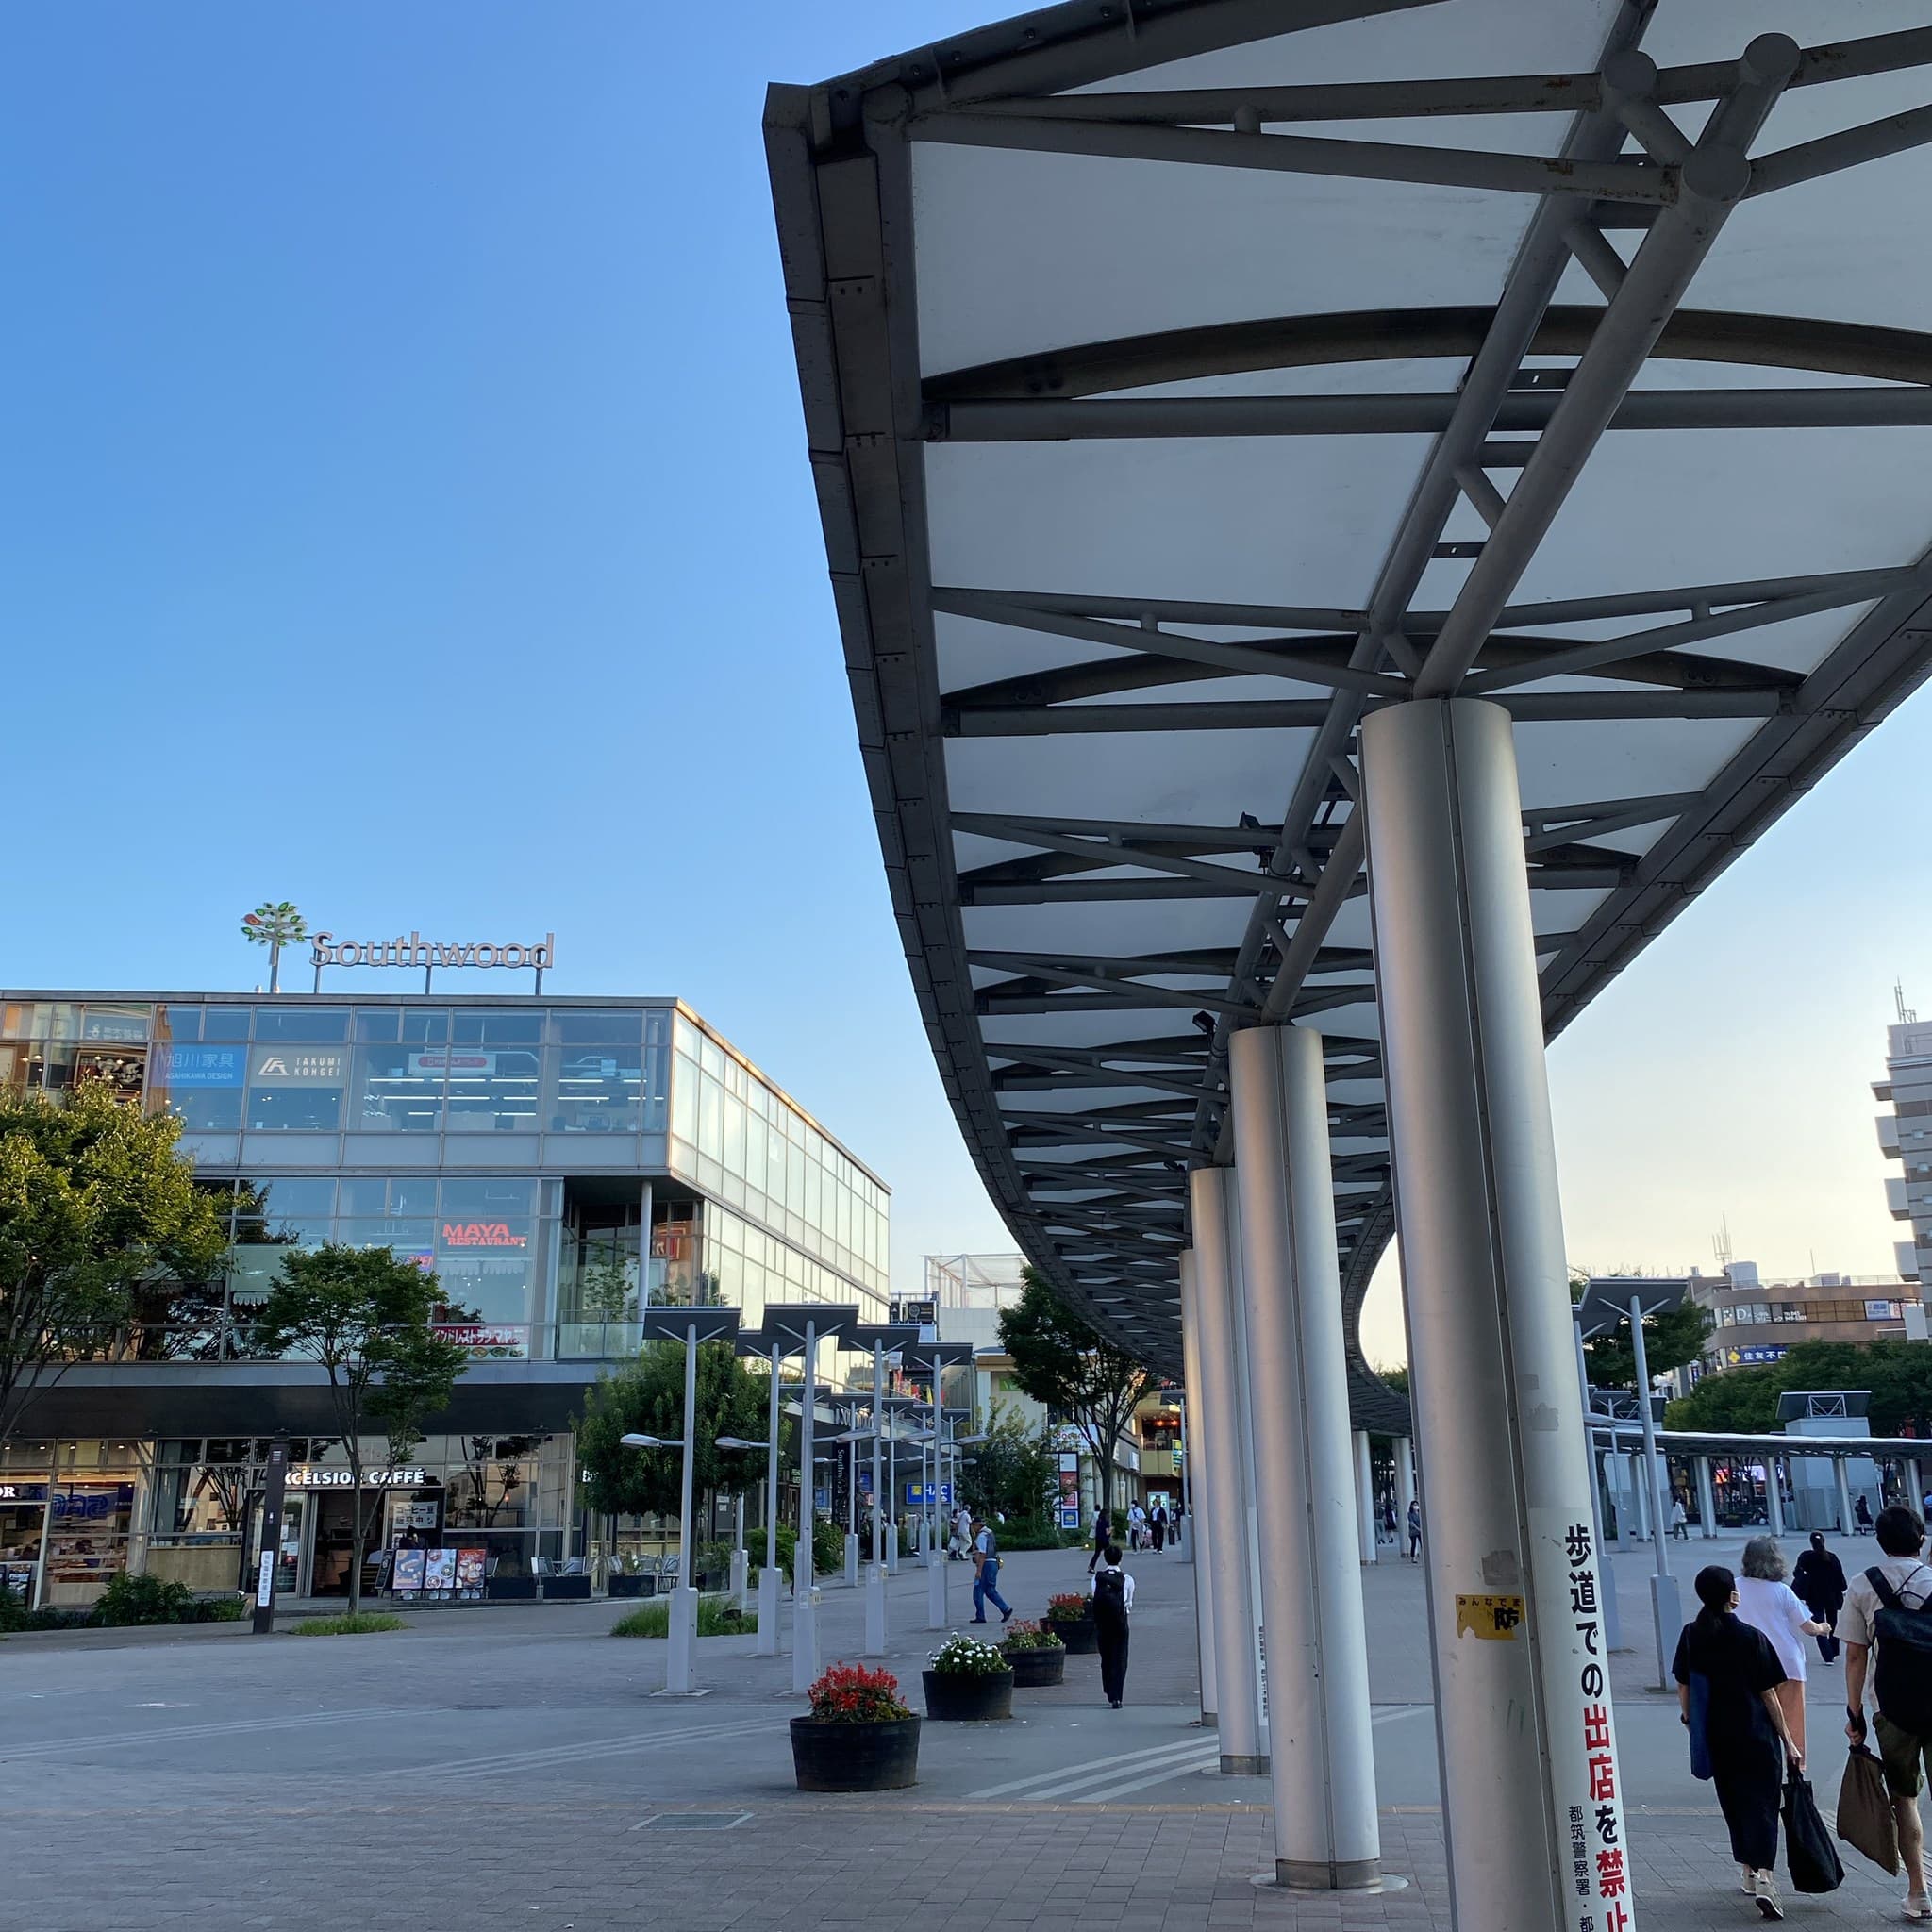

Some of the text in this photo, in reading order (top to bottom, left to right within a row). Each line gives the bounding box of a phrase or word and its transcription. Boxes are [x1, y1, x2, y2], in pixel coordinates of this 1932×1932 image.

[309, 931, 555, 969] Southwood
[166, 1053, 235, 1068] 旭川家具
[295, 1057, 341, 1066] TAKUMI
[294, 1068, 341, 1076] KOHGEI
[442, 1224, 510, 1237] MAYA
[447, 1237, 527, 1246] RESTAURANT
[369, 1468, 425, 1484] CAFFÉ
[924, 1485, 948, 1495] HC
[1565, 1523, 1628, 1932] 歩道での出店を禁止
